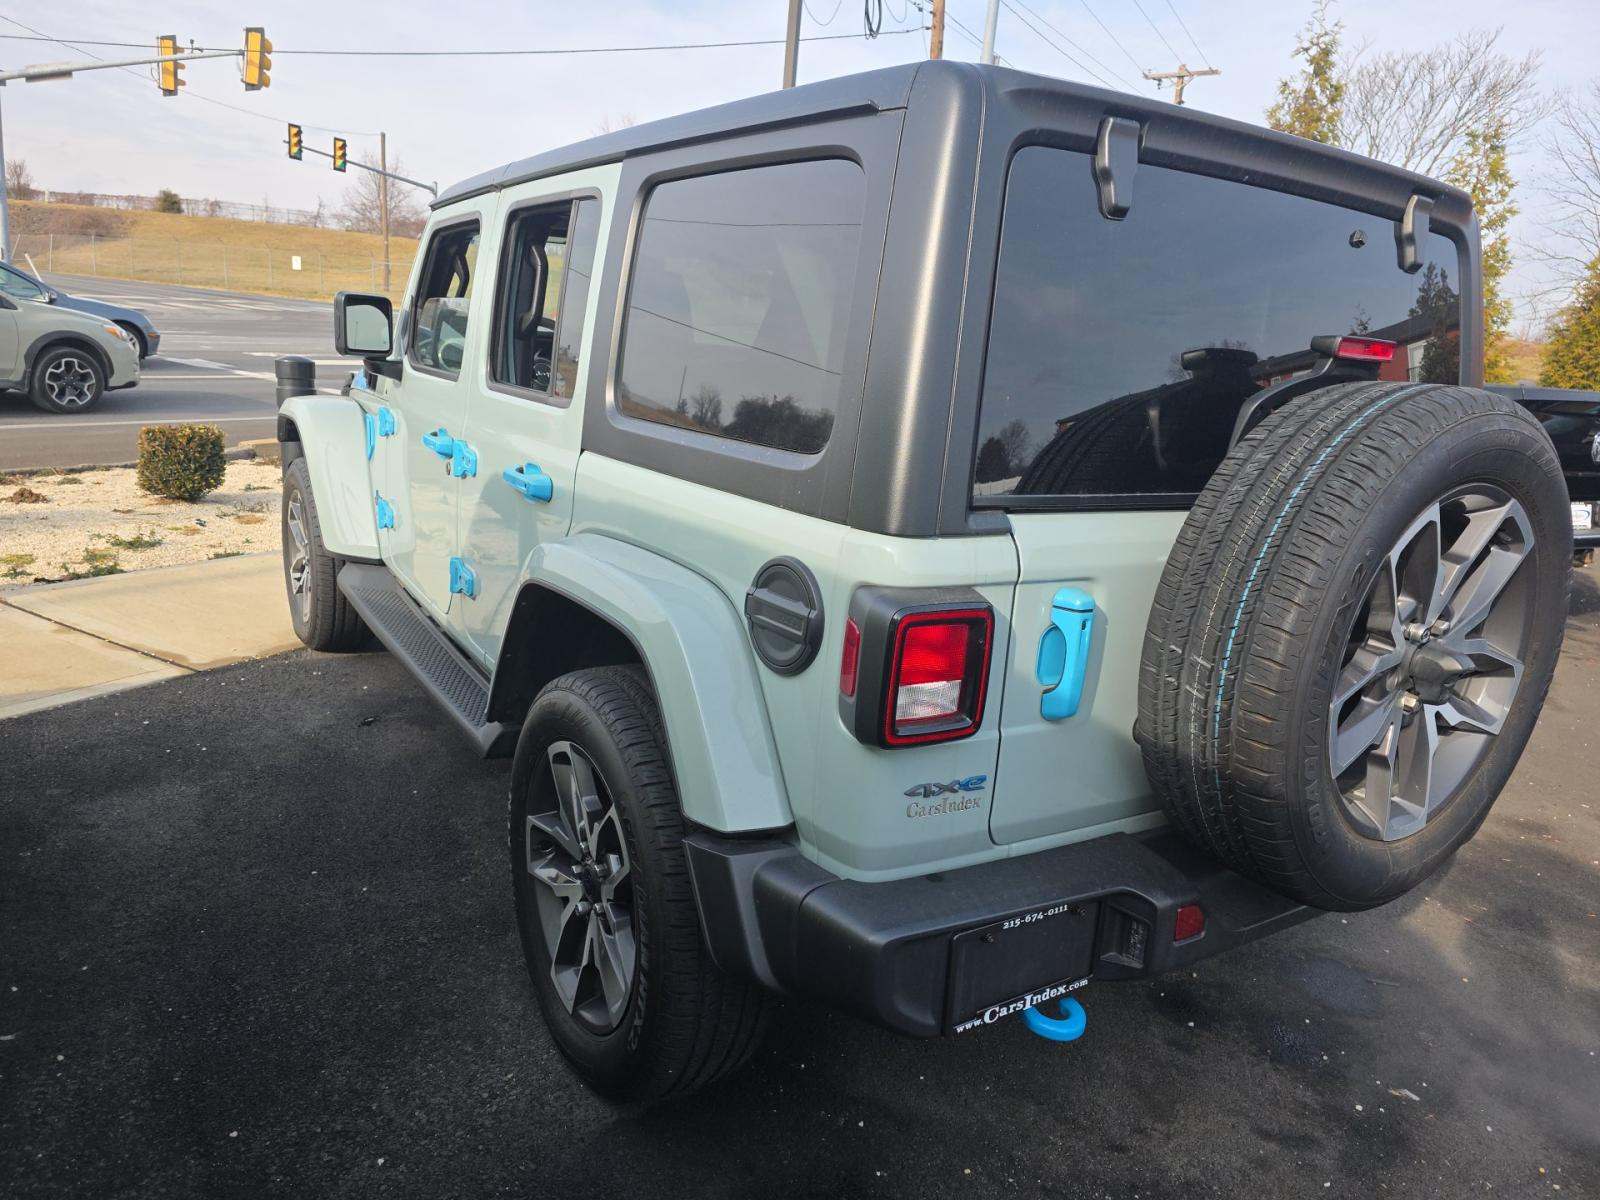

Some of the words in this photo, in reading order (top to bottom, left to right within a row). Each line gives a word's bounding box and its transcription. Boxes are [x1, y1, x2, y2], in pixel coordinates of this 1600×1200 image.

[906, 796, 982, 818] CarsIndex
[1002, 904, 1068, 930] 215-674-0111
[956, 978, 1088, 1034] www.CarsIndex.com
